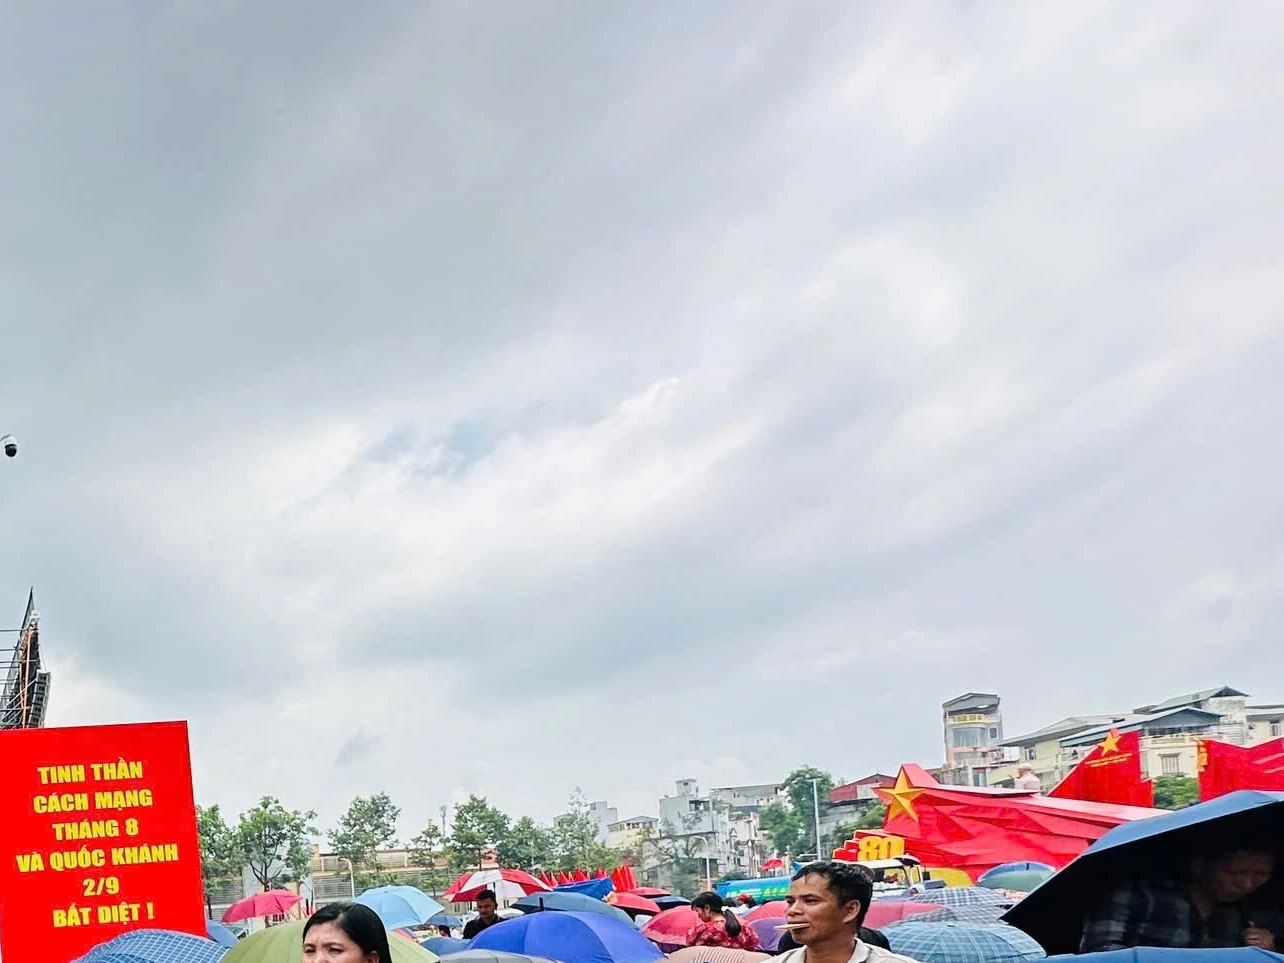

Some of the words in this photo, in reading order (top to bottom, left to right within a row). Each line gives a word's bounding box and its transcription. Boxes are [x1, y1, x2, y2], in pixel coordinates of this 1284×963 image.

[37, 765, 85, 784] TINH
[90, 757, 143, 781] THẦN
[33, 792, 89, 813] CÁCH
[95, 789, 153, 811] MẠNG
[52, 819, 119, 840] THÁNG
[125, 818, 139, 836] 8
[16, 851, 45, 872] VÀ
[49, 844, 106, 872] QUỐC
[111, 843, 179, 865] KHÁNH
[82, 876, 120, 896] 2/9
[52, 903, 92, 928] BẤT
[97, 901, 141, 925] DIỆT
[146, 902, 155, 919] !
